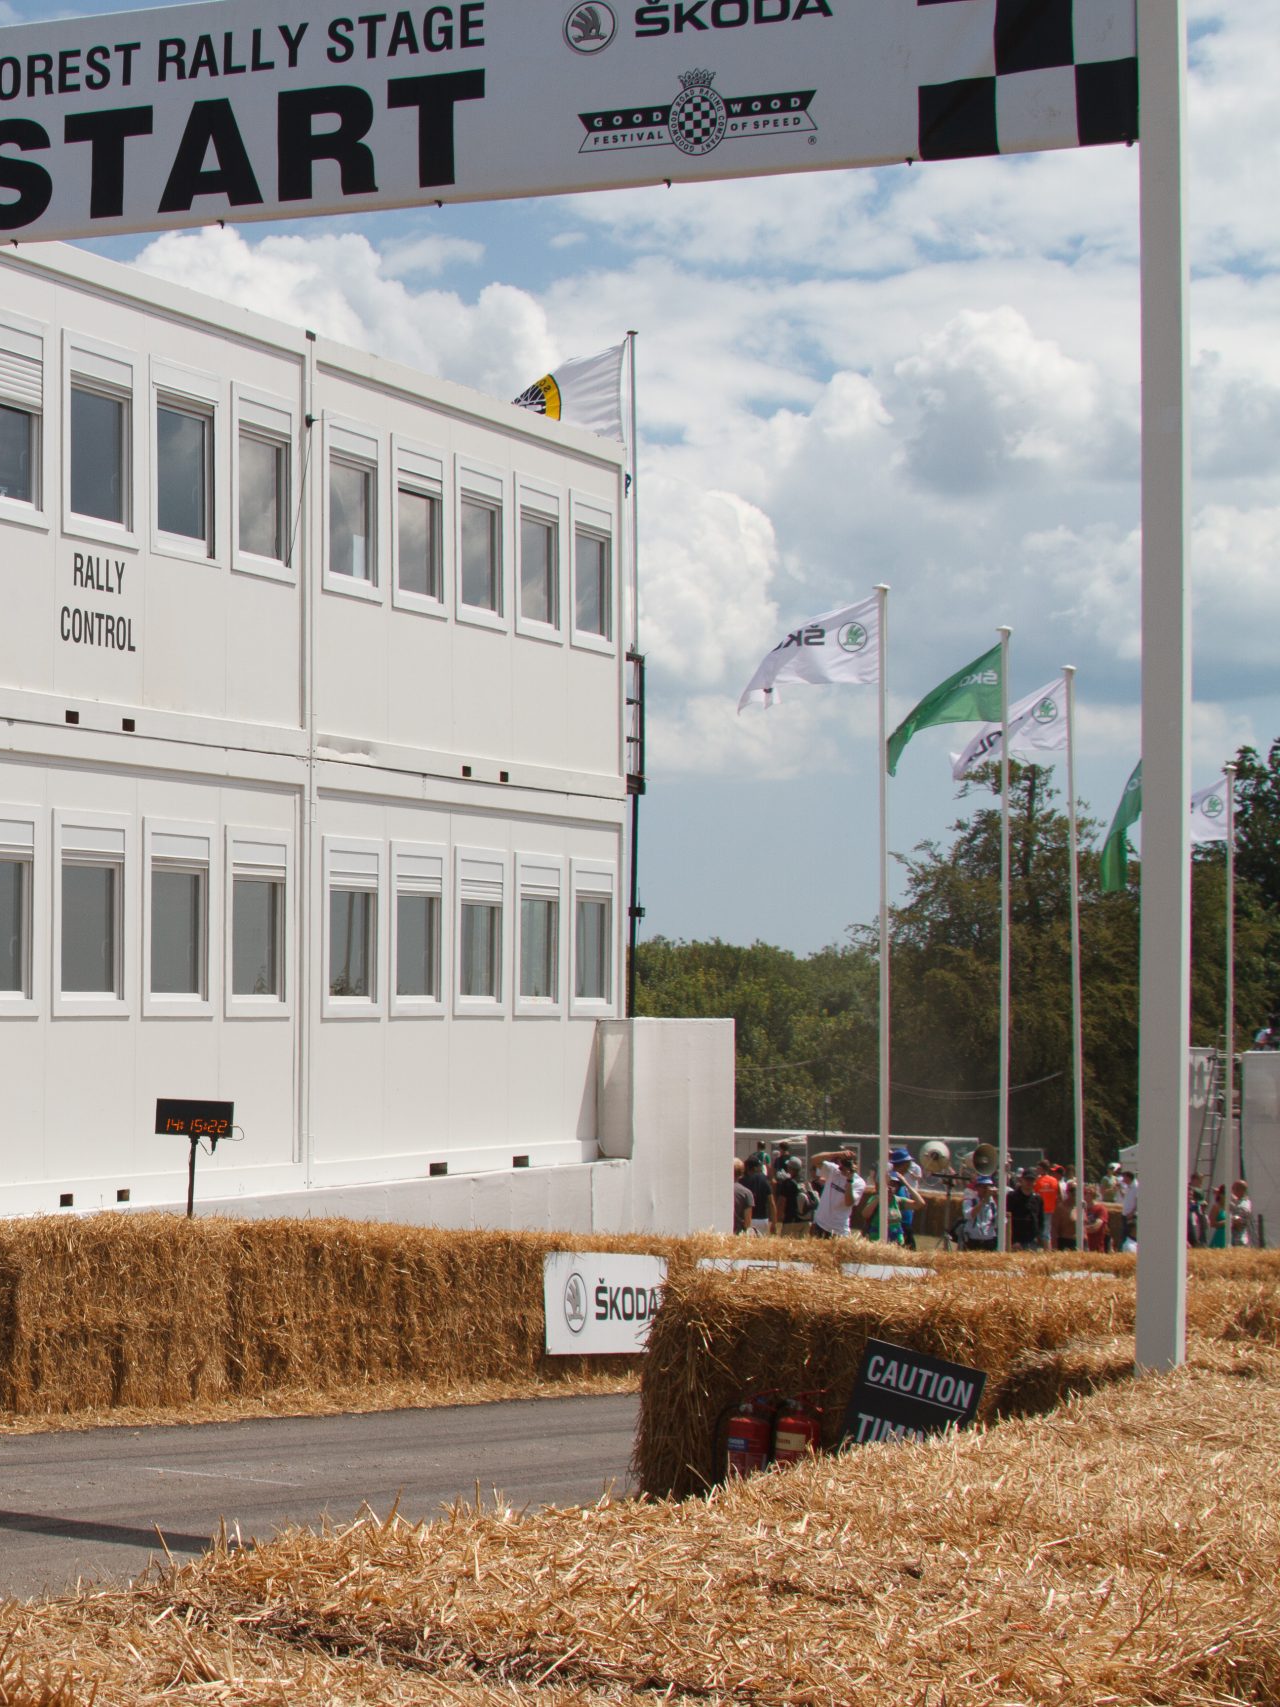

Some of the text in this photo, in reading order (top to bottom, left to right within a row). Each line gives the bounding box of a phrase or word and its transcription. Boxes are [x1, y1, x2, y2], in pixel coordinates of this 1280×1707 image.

[635, 0, 834, 37] ŠKODA
[158, 22, 309, 82] RALLY
[326, 2, 486, 63] STAGE
[594, 97, 801, 127] GOOD WOOD
[594, 116, 801, 145] FESTIVAL OF SPEED
[73, 552, 125, 594] RALLY
[60, 606, 136, 652] CONTROL
[867, 1355, 974, 1409] CAUTION
